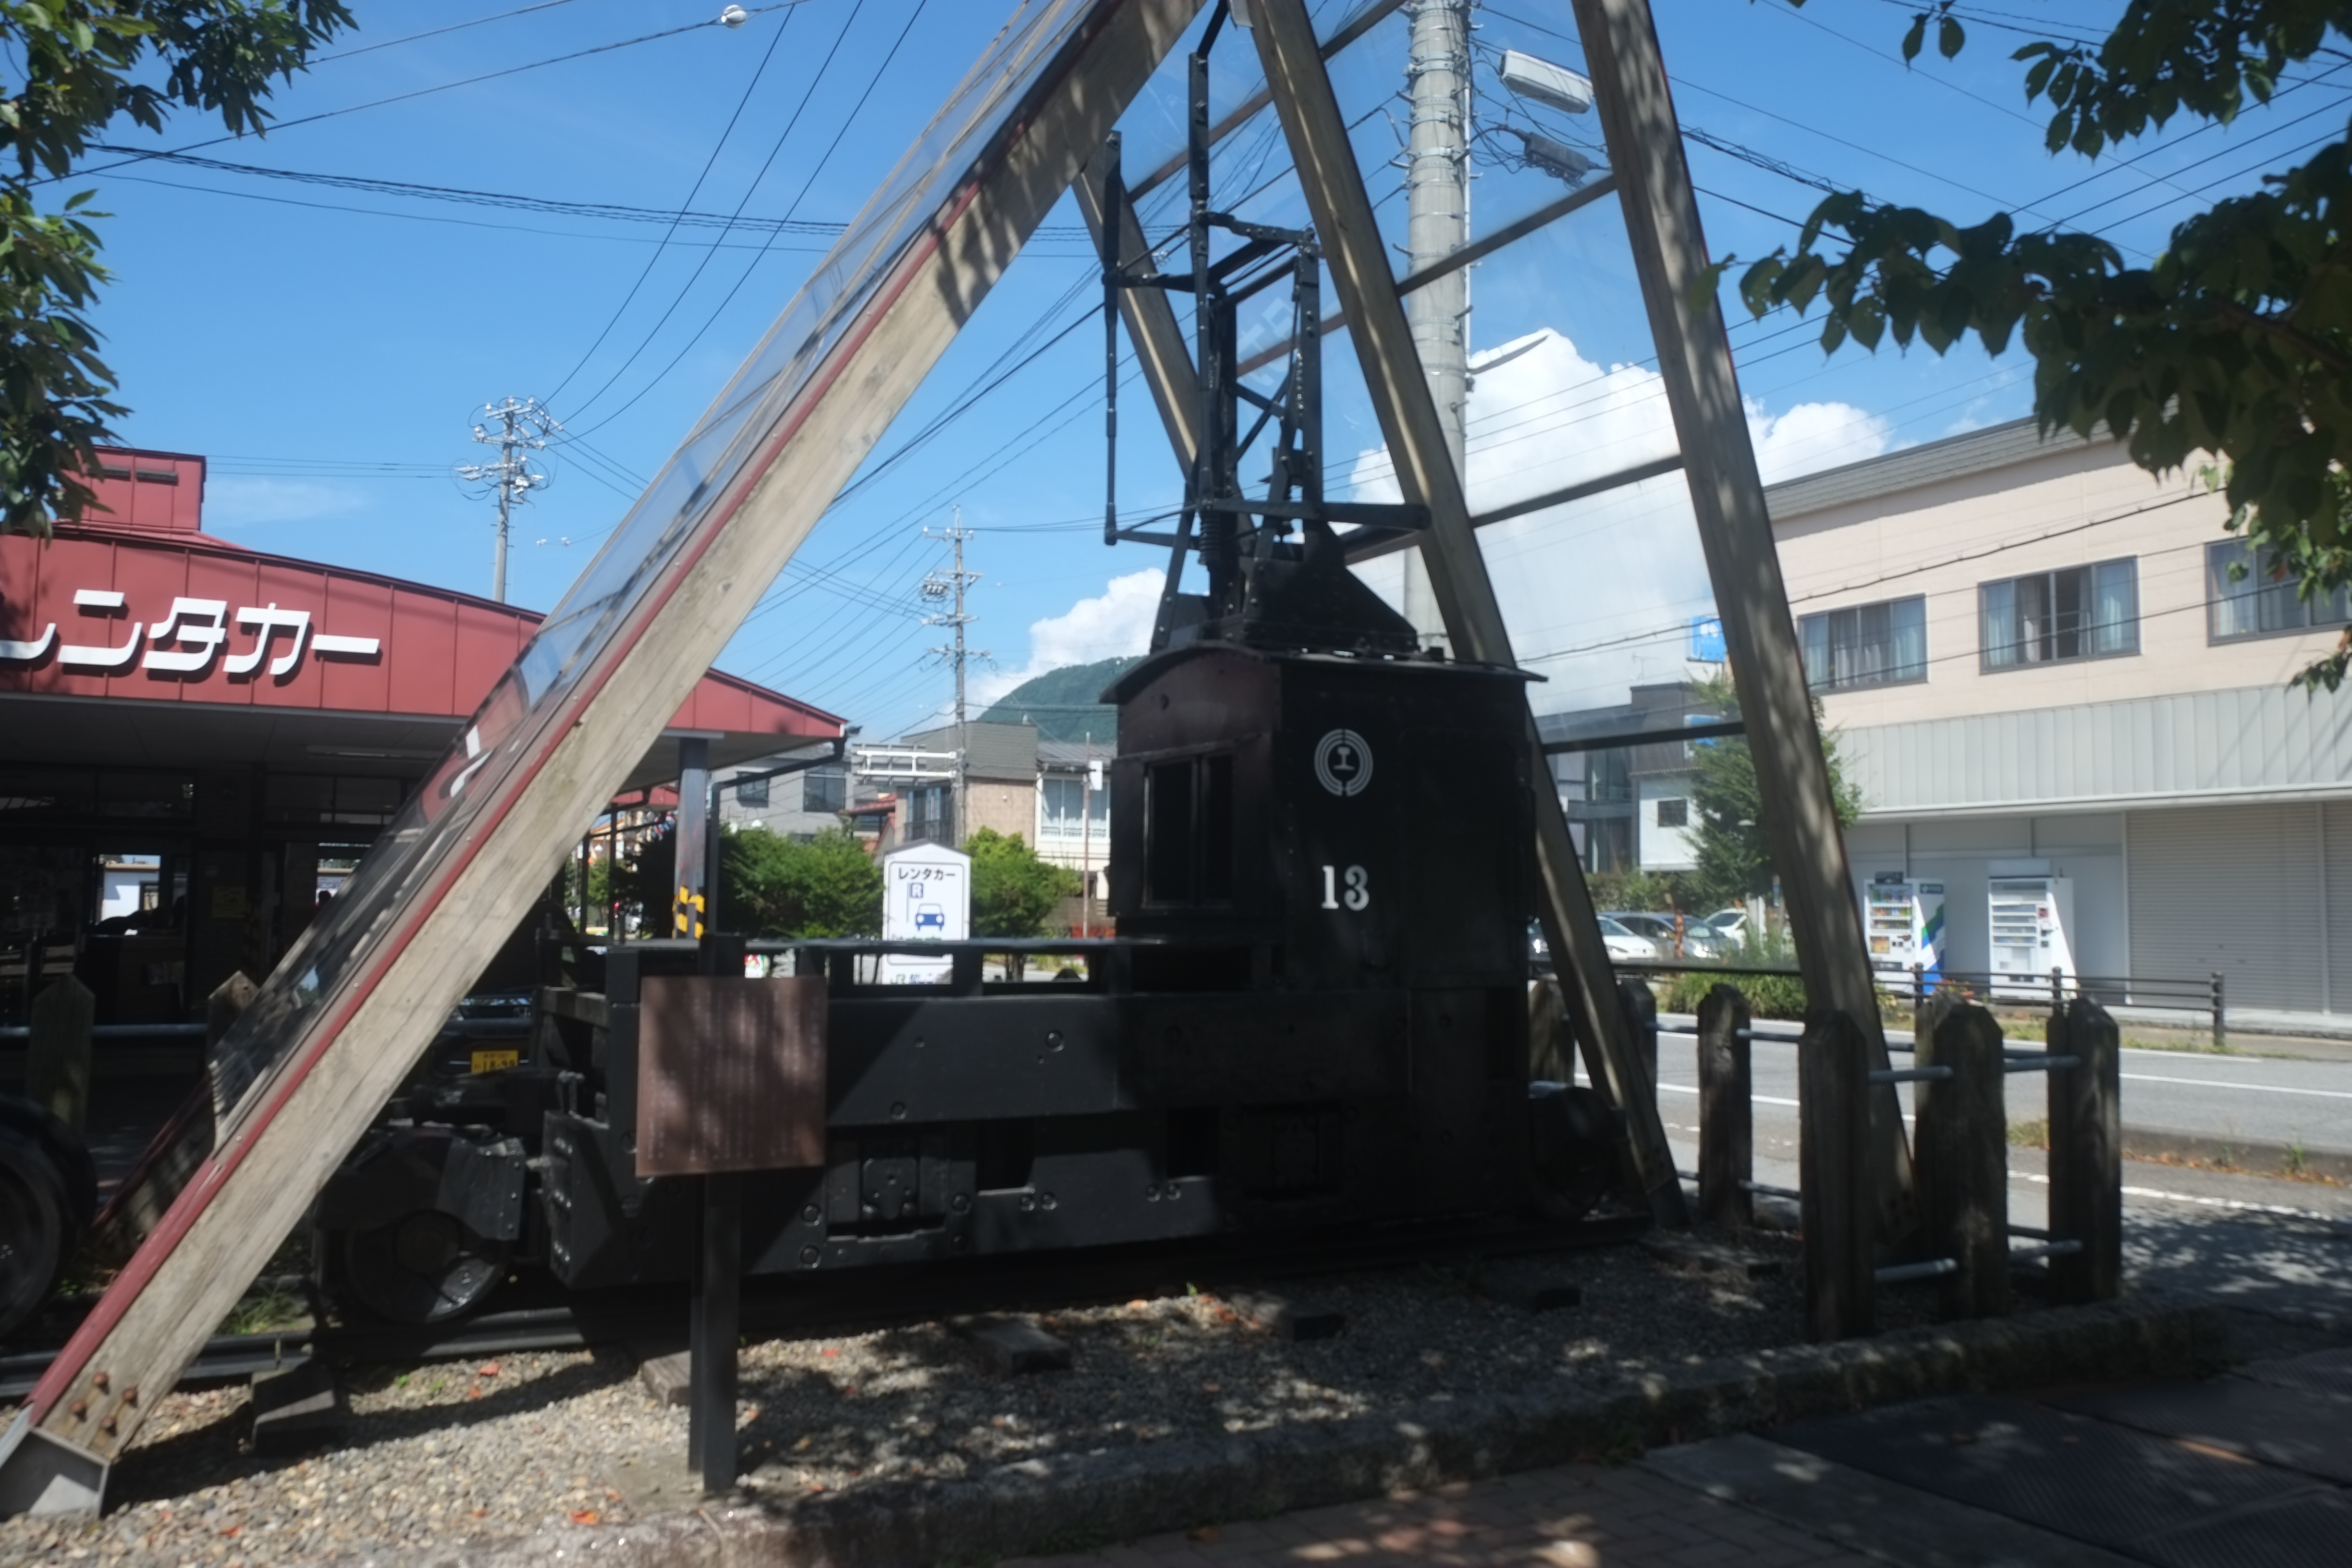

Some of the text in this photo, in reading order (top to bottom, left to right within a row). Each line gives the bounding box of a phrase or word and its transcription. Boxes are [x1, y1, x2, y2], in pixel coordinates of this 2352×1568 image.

[898, 868, 956, 881] レンタカー
[1321, 864, 1370, 911] 13
